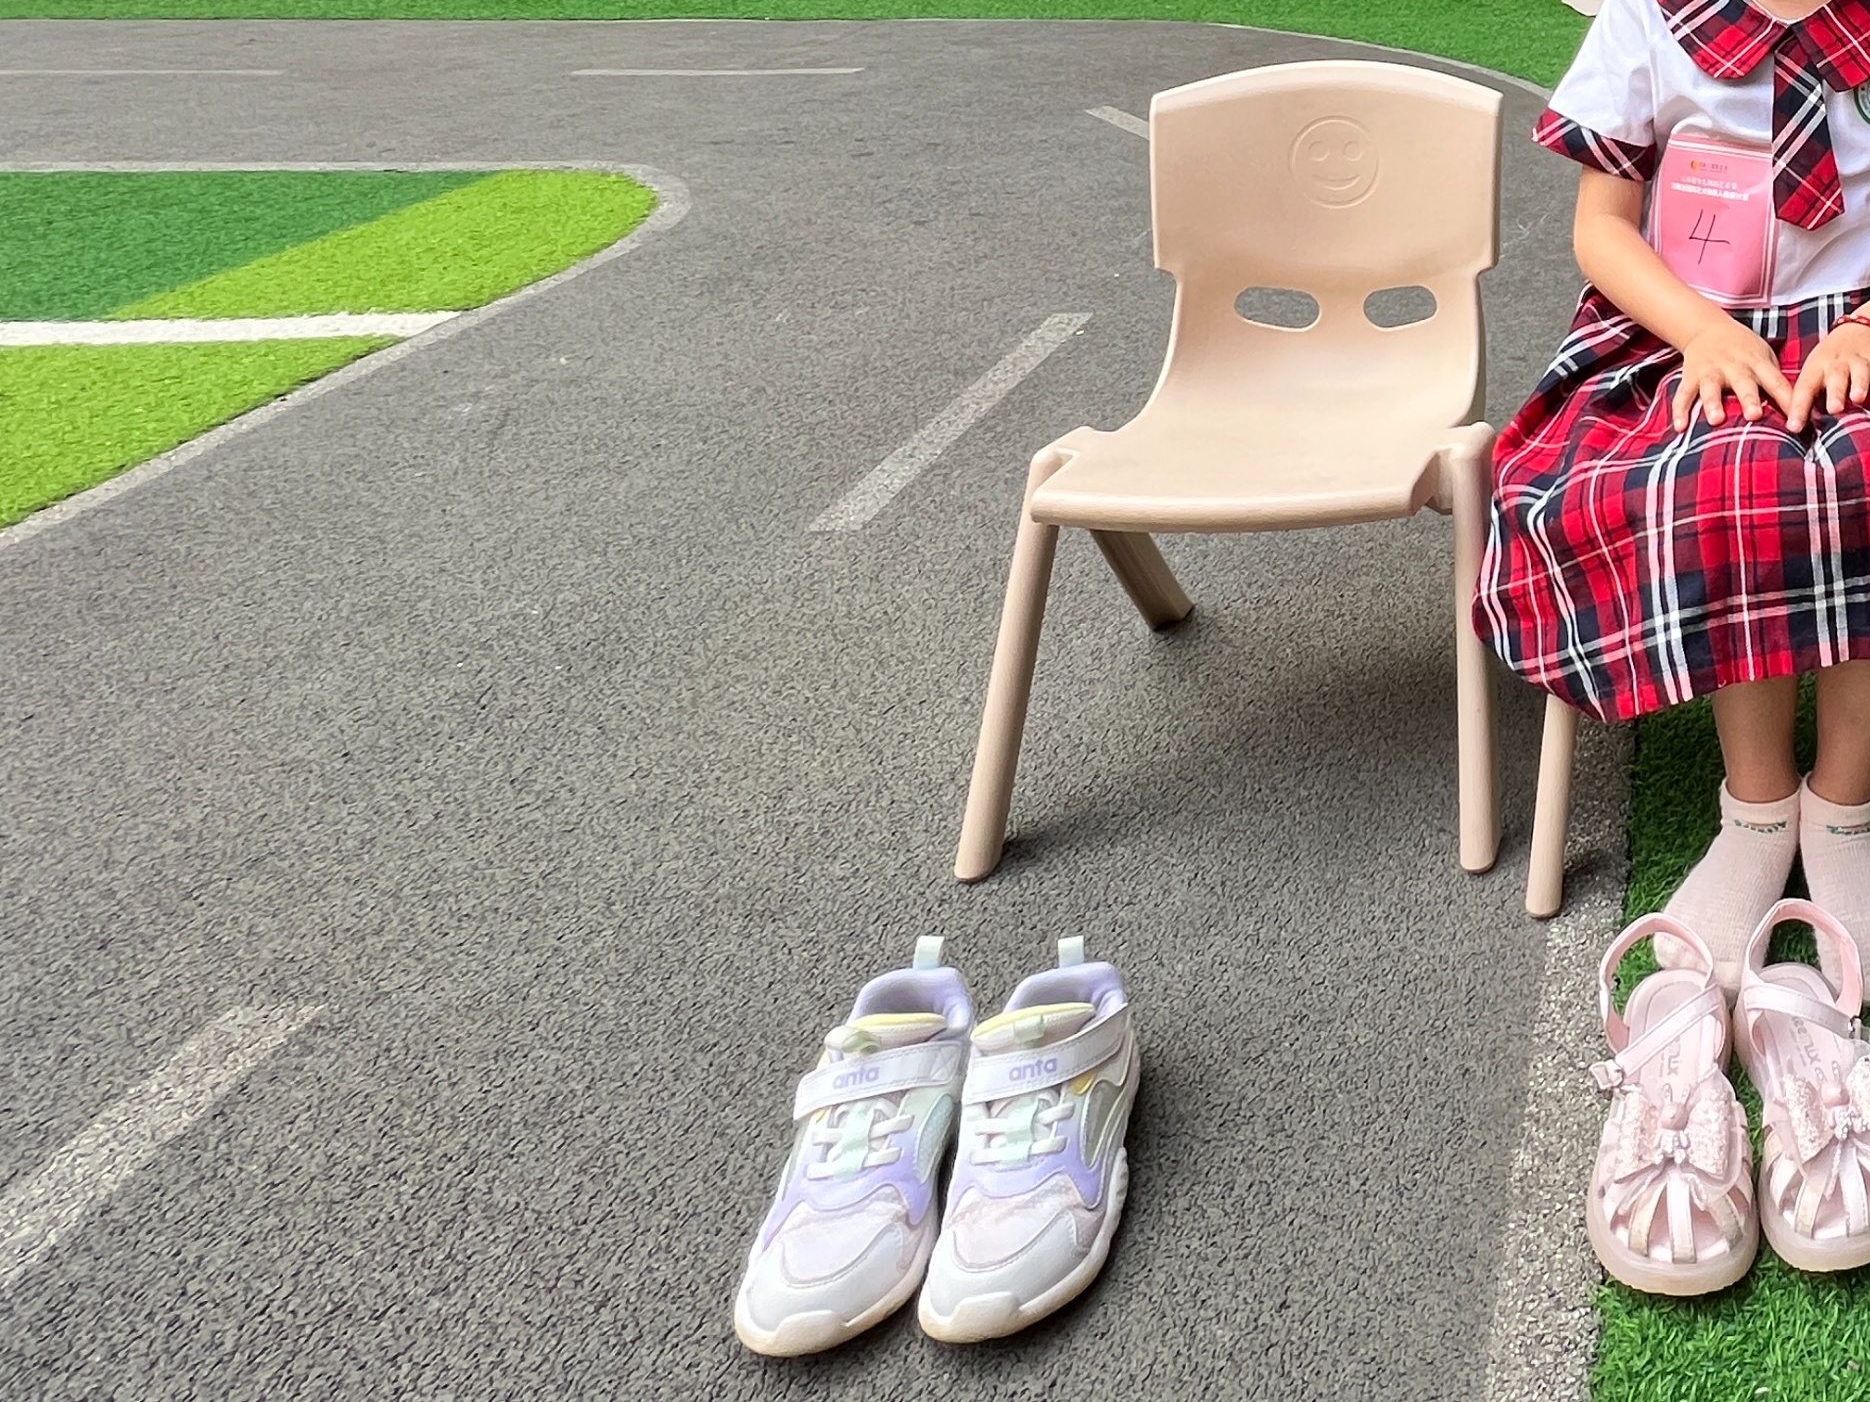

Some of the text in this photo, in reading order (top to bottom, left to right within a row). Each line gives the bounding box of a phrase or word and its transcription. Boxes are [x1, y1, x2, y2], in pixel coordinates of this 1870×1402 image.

[1688, 208, 1730, 265] 4
[832, 1065, 880, 1090] anta
[1008, 1057, 1058, 1082] anta
